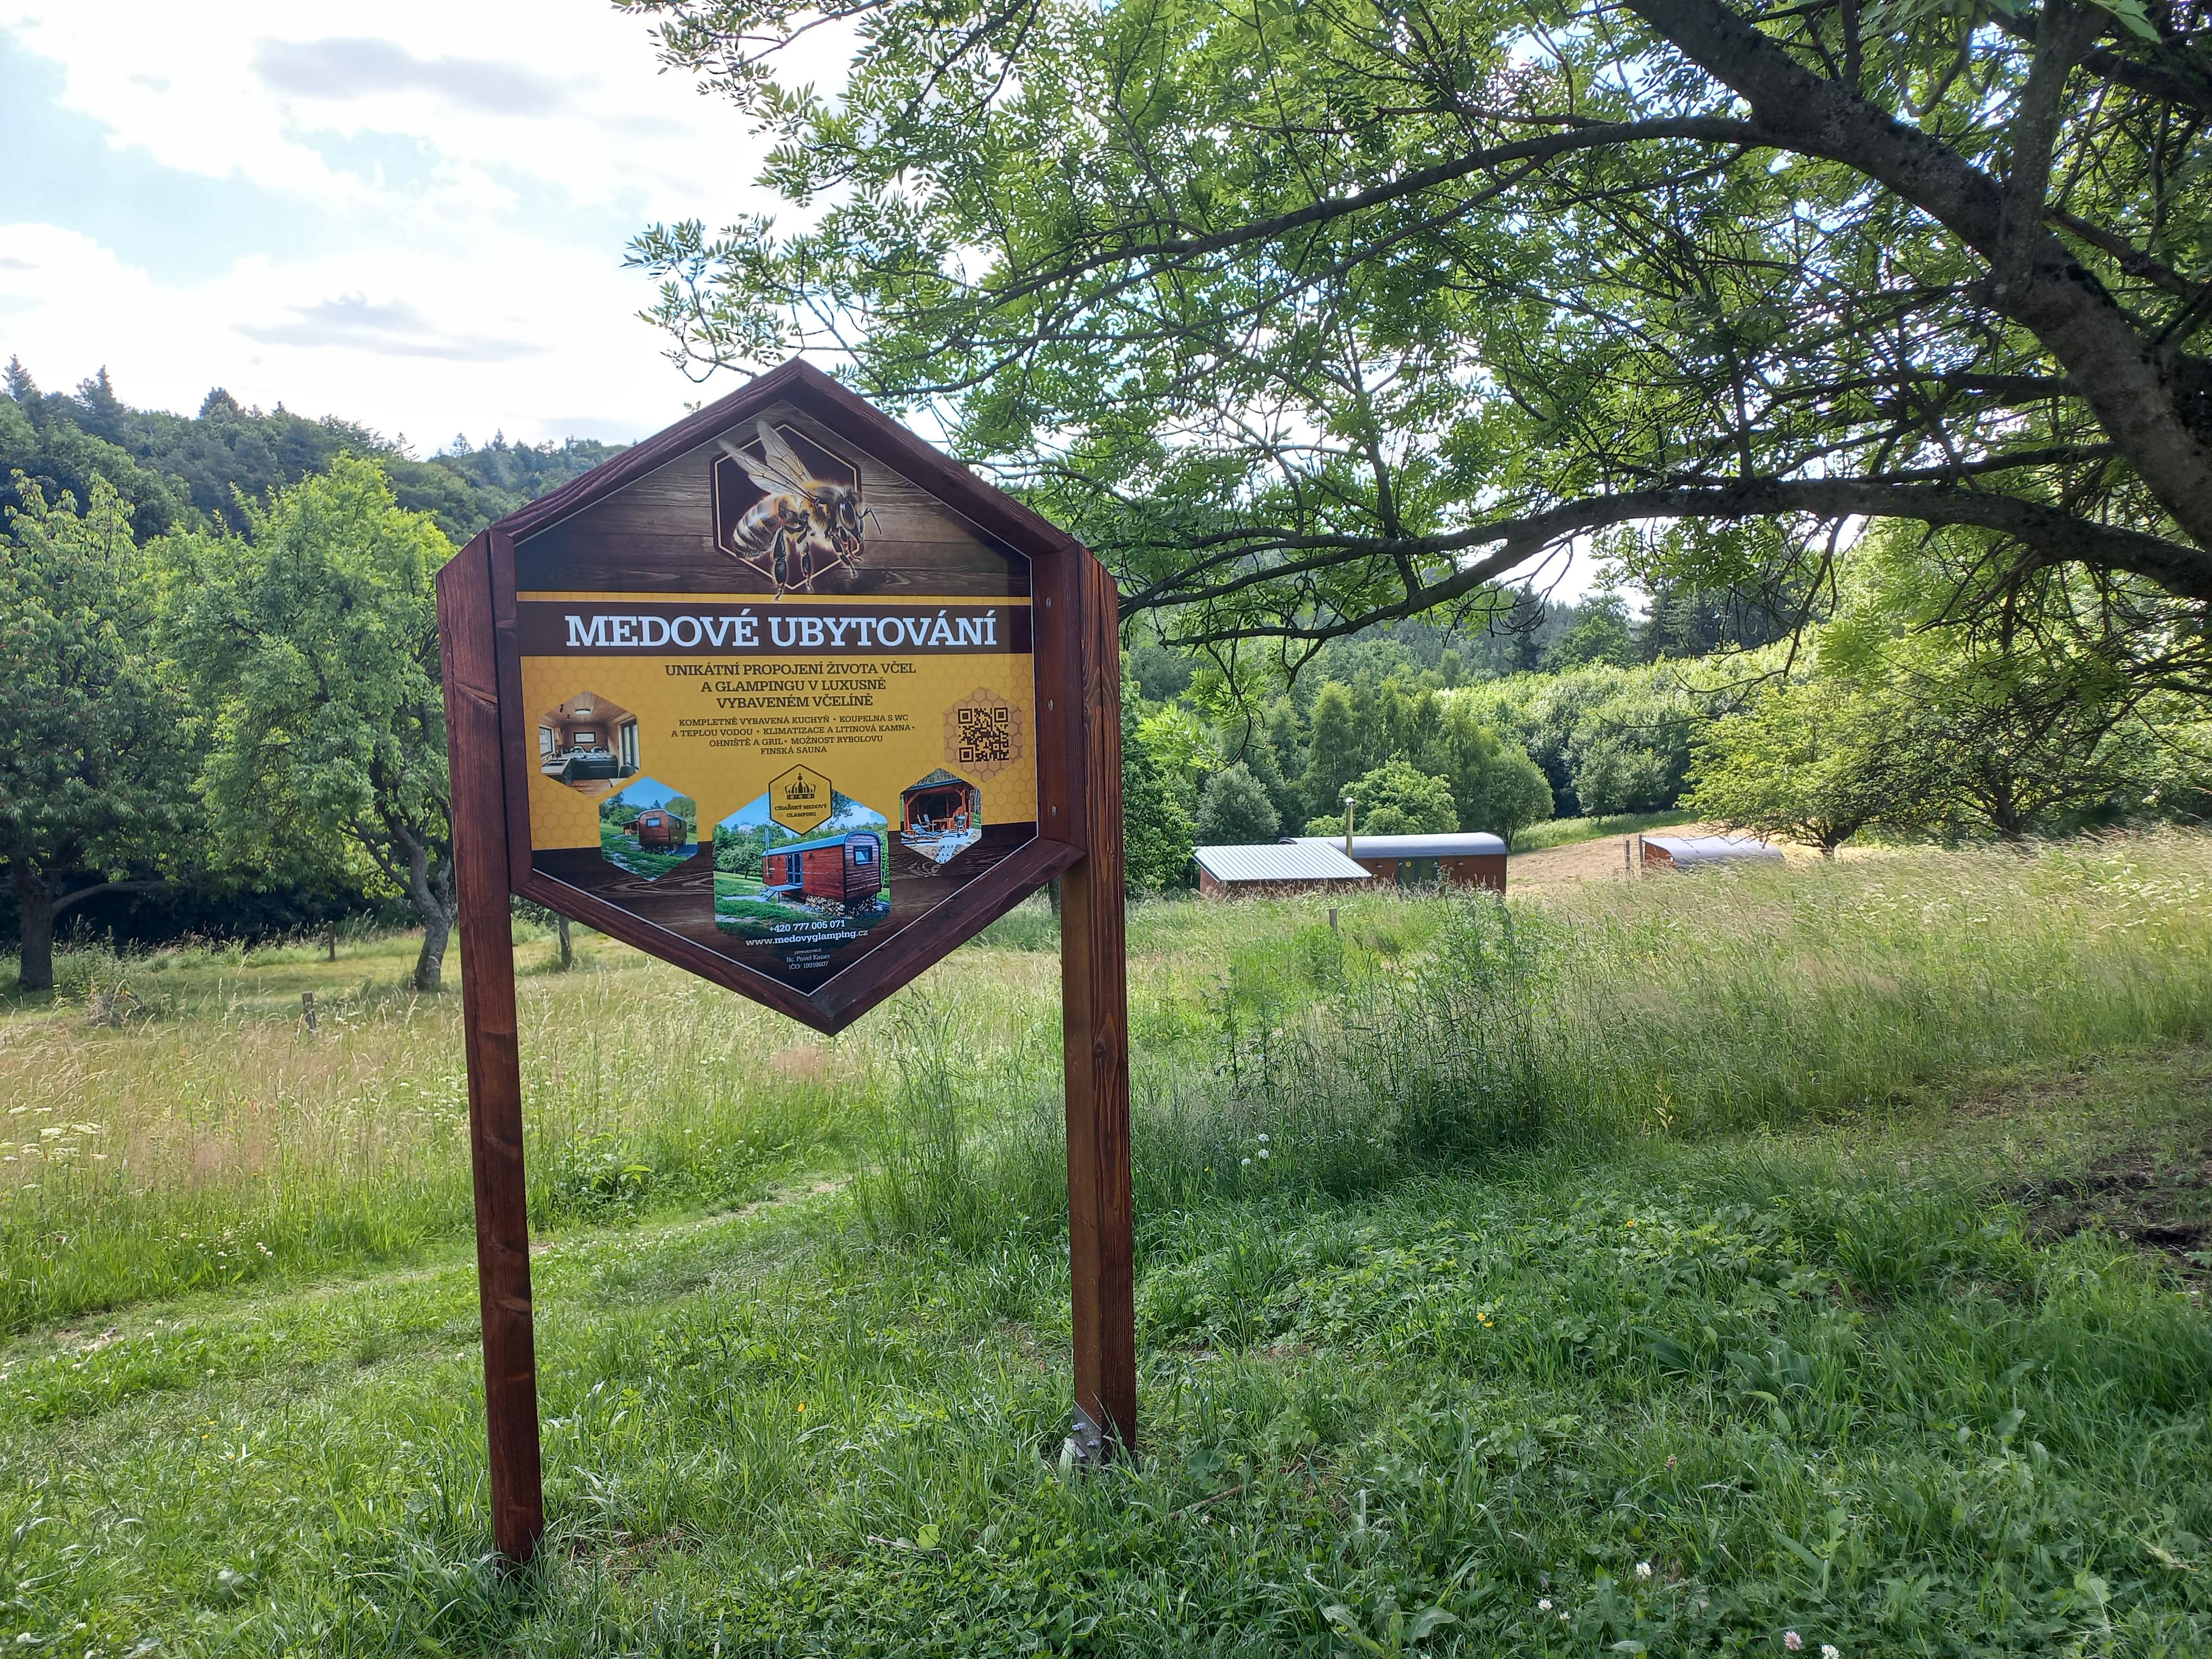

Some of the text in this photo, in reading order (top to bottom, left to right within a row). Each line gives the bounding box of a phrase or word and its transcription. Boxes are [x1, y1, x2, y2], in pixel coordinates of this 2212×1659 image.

[564, 608, 997, 646] MEDOVÉ UBYTOVÁNÍ
[665, 660, 916, 675] UNIKÁTNÍ PROPOJENÍ ŽIVOTA VČEL
[701, 676, 886, 692] A GLAMPINGU V LUXUSNĚ
[716, 693, 873, 708] VYBAVENÉM VČELÍNĚ
[679, 717, 737, 726] KOMPLETNĚ
[739, 716, 790, 725] VYBAVENÁ
[792, 714, 830, 723] KUCHYŇ
[836, 724, 876, 733] LITINOVÁ
[709, 738, 750, 747] OHNIŠTĚ
[791, 736, 834, 744] MOŽNOST
[760, 746, 794, 755] FINSKÁ
[769, 920, 845, 933] +420 777 005 071
[746, 930, 868, 946] www.medovyglamping.cz
